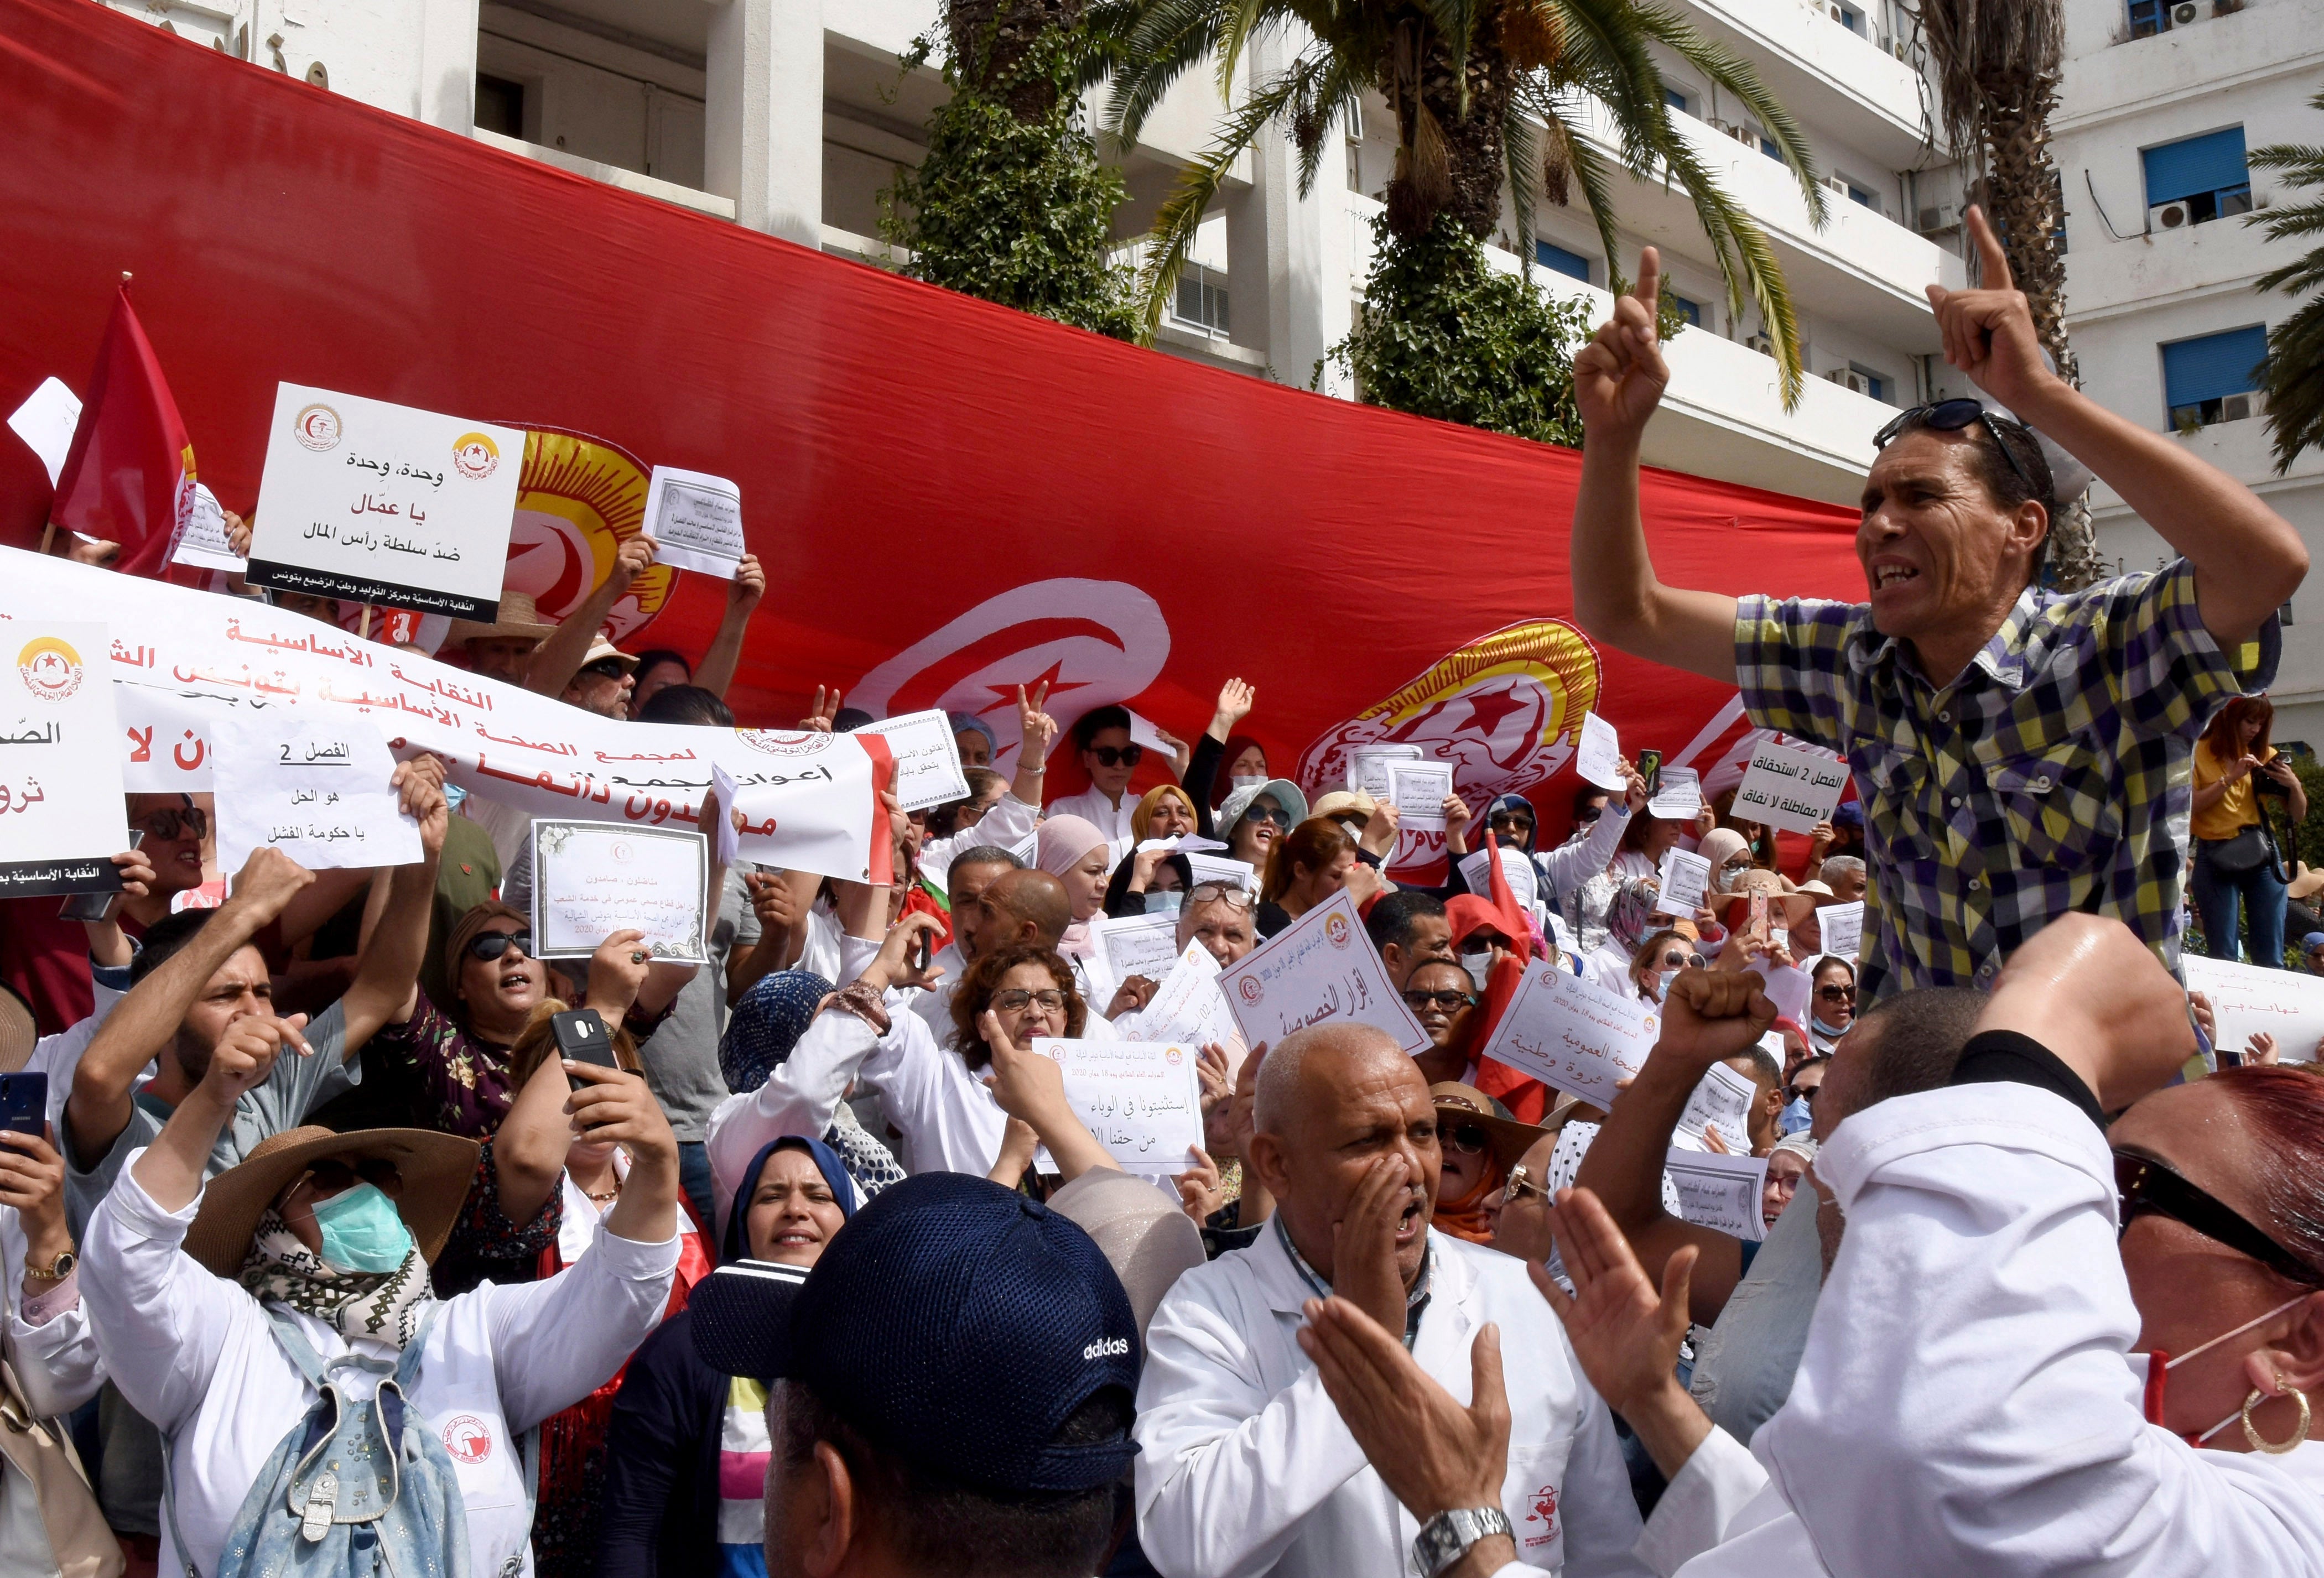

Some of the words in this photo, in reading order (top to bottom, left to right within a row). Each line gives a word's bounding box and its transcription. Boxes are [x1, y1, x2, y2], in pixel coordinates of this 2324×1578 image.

[409, 502, 426, 525] يا
[304, 522, 336, 540] المال
[341, 530, 377, 551] رأس
[383, 534, 427, 556] سلطة
[272, 571, 302, 585] بتونس
[387, 589, 410, 602] بمركز
[226, 617, 373, 668] الأساسية
[110, 638, 155, 669] الش
[173, 664, 300, 706] بتونس
[389, 662, 493, 712] النقابة
[318, 675, 461, 728] الأساسية
[475, 721, 578, 757] الصحة
[280, 744, 292, 761] 2
[305, 741, 350, 762] الفصل
[594, 747, 698, 765] لمجمع
[921, 742, 946, 757] القانون
[736, 763, 833, 786] أعوان
[917, 761, 939, 775] يتحقق
[1752, 756, 1800, 778] استحقاق
[1800, 767, 1810, 782] 2
[476, 752, 611, 804] دائما
[1811, 771, 1843, 789] الفصل
[291, 789, 318, 805] الحل
[324, 791, 339, 805] هو
[1742, 789, 1769, 805] نفاق
[1769, 795, 1780, 808] لا
[1780, 798, 1818, 817] مماطلة
[1820, 808, 1830, 820] لا
[267, 826, 303, 843] الفشل
[309, 824, 350, 842] حكومة
[355, 826, 365, 842] يا
[586, 876, 618, 884] صامدون
[627, 877, 658, 886] مناضلون
[554, 894, 577, 904] الشعب
[580, 894, 599, 903] خدمة
[601, 894, 612, 904] في
[614, 897, 637, 905] عمومي
[659, 900, 674, 909] قطاع
[564, 909, 589, 921] الشمالية
[591, 910, 612, 923] بتونس
[643, 914, 660, 923] الصحة
[575, 924, 594, 934] 2020
[1346, 966, 1374, 1017] إقرار
[1553, 996, 1569, 1008] 2020
[1581, 1008, 1589, 1017] 18
[1511, 1033, 1557, 1067] وطنية
[1562, 1028, 1610, 1061] العمومية
[1611, 1049, 1642, 1075] لصحة
[1071, 1068, 1088, 1077] 2020
[1101, 1069, 1109, 1077] 18
[1566, 1061, 1603, 1085] ثروة
[1090, 1094, 1119, 1118] الوباء
[1123, 1096, 1135, 1120] في
[1109, 1127, 1134, 1145] حقنا
[1139, 1137, 1156, 1152] من
[1084, 1336, 1129, 1360] adidas
